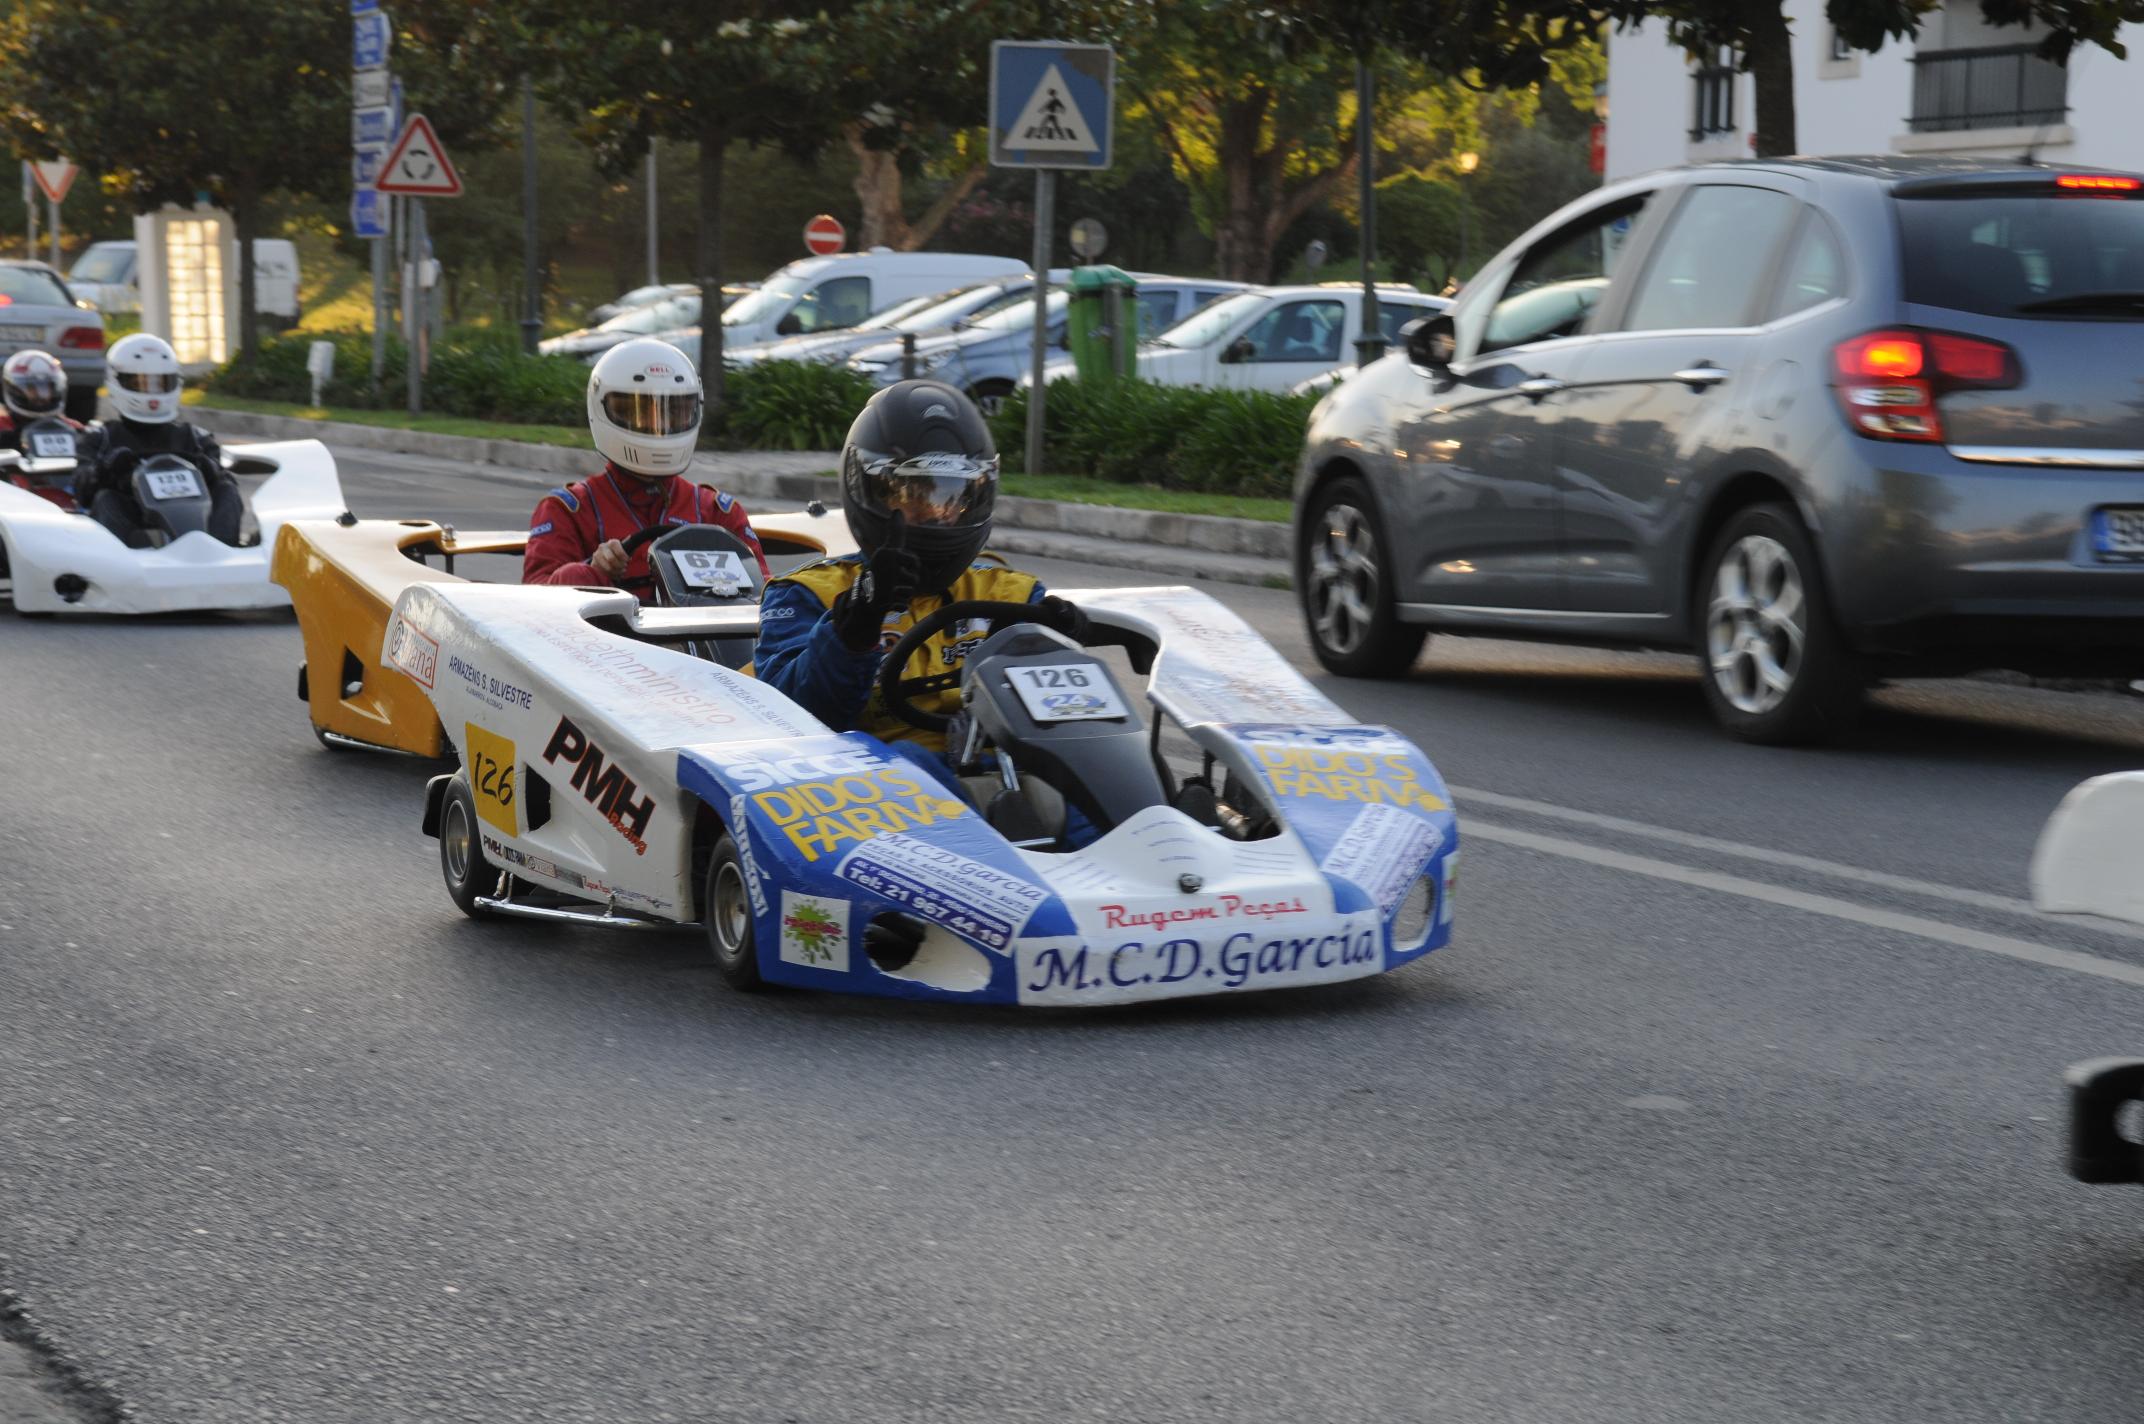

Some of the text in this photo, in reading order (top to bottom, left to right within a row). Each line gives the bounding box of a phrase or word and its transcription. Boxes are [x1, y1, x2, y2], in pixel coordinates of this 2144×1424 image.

[684, 553, 729, 569] 67
[490, 677, 533, 710] SILVESTRE
[1022, 668, 1090, 688] 126
[474, 751, 515, 807] 126
[542, 714, 657, 840] PMH
[1253, 745, 1417, 782] DIDO'S
[752, 769, 922, 826] DIDO'S
[849, 866, 884, 890] Tel:
[883, 883, 911, 902] 21
[911, 895, 951, 922] 967
[1098, 894, 1309, 932] Rugem Peças
